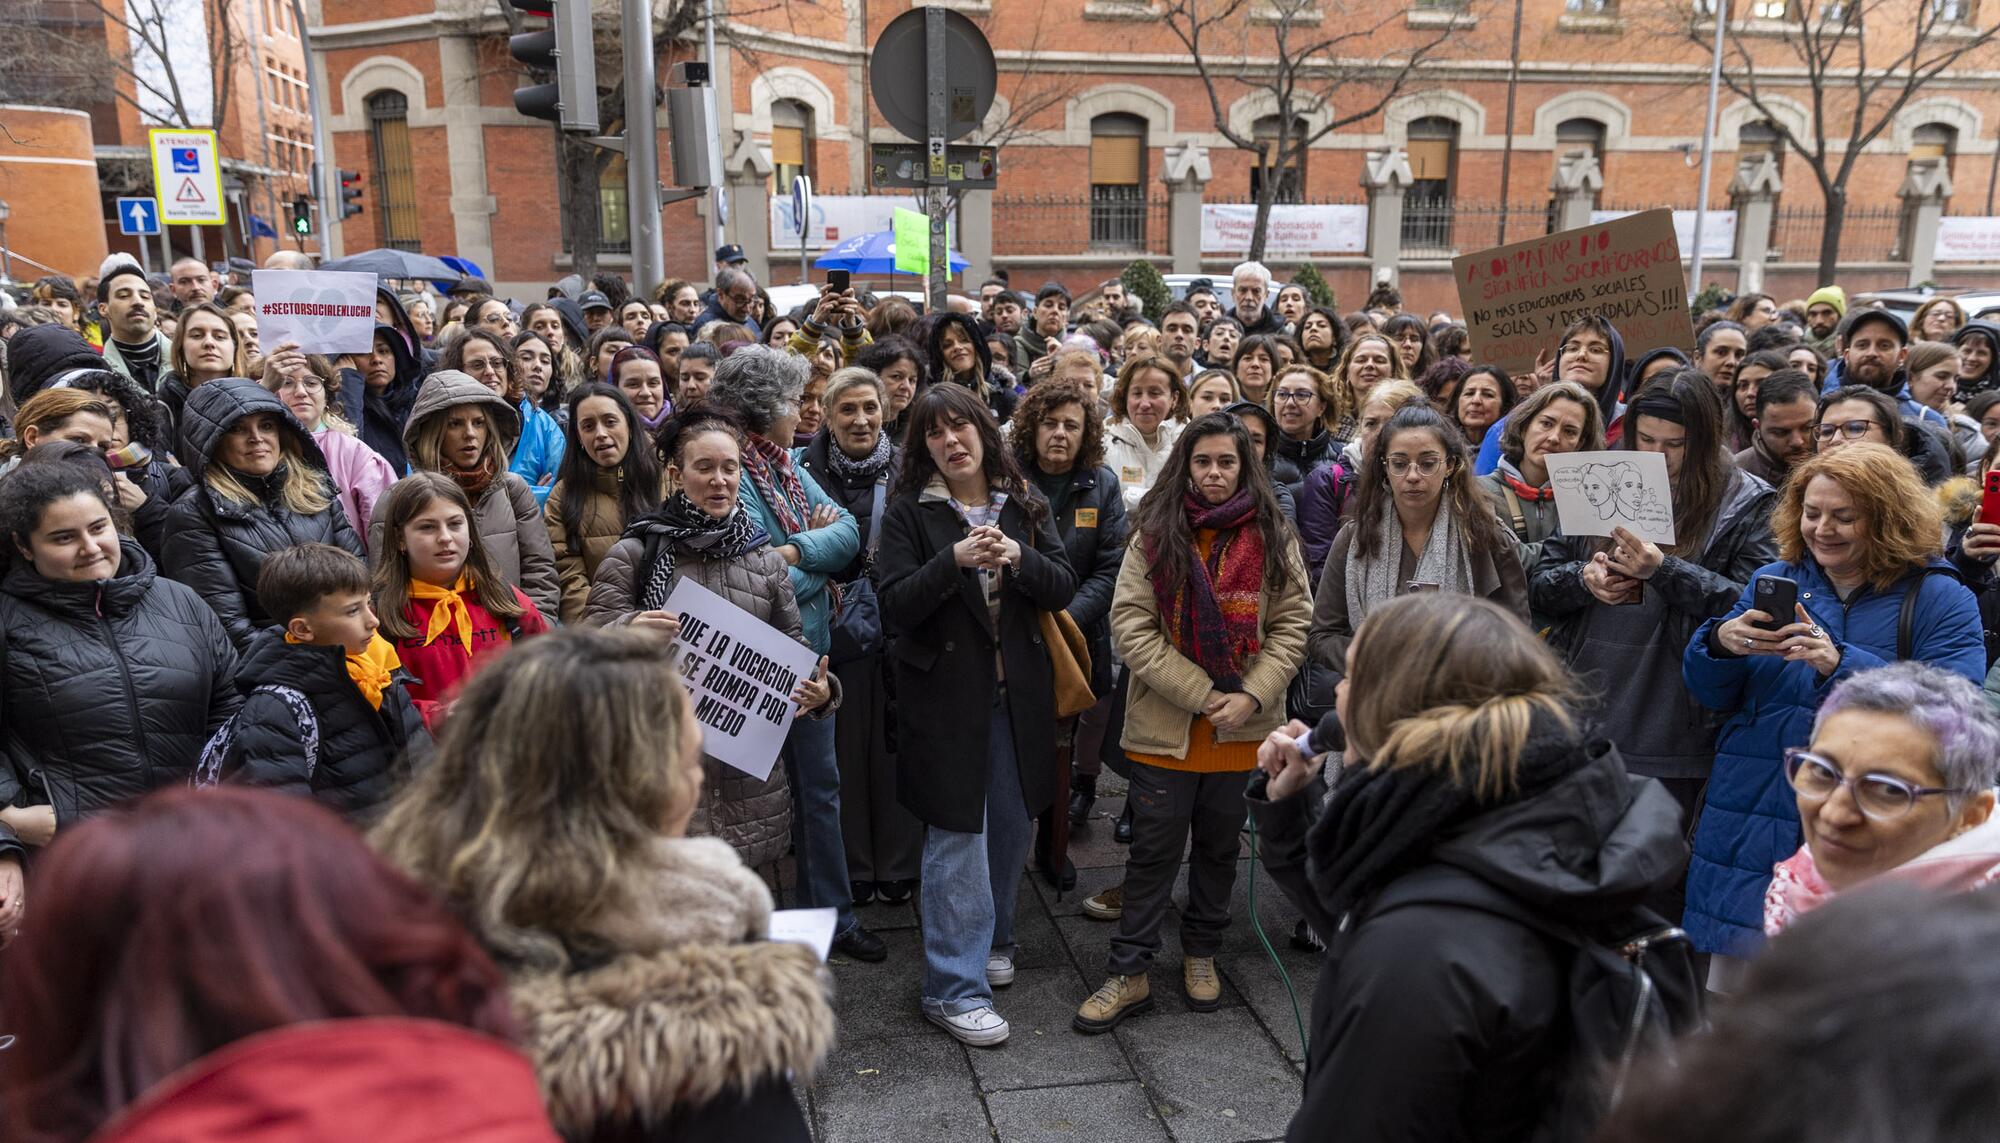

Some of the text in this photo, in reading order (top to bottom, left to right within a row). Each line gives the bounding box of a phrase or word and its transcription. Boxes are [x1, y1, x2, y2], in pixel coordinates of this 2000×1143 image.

[262, 302, 371, 318] #SECTORSOCIALENLUCHA
[1474, 309, 1491, 326] NO
[1518, 287, 1586, 315] EDUCADORAS
[1592, 274, 1647, 299] SOCIALES
[1492, 317, 1538, 338] SOLAS
[1547, 314, 1556, 330] Y
[705, 630, 731, 661] LA
[728, 641, 798, 697] VOCACIÓN
[679, 651, 706, 682] SE
[701, 663, 761, 710] ROMPA
[755, 692, 788, 726] POR
[695, 695, 747, 738] MIEDO
